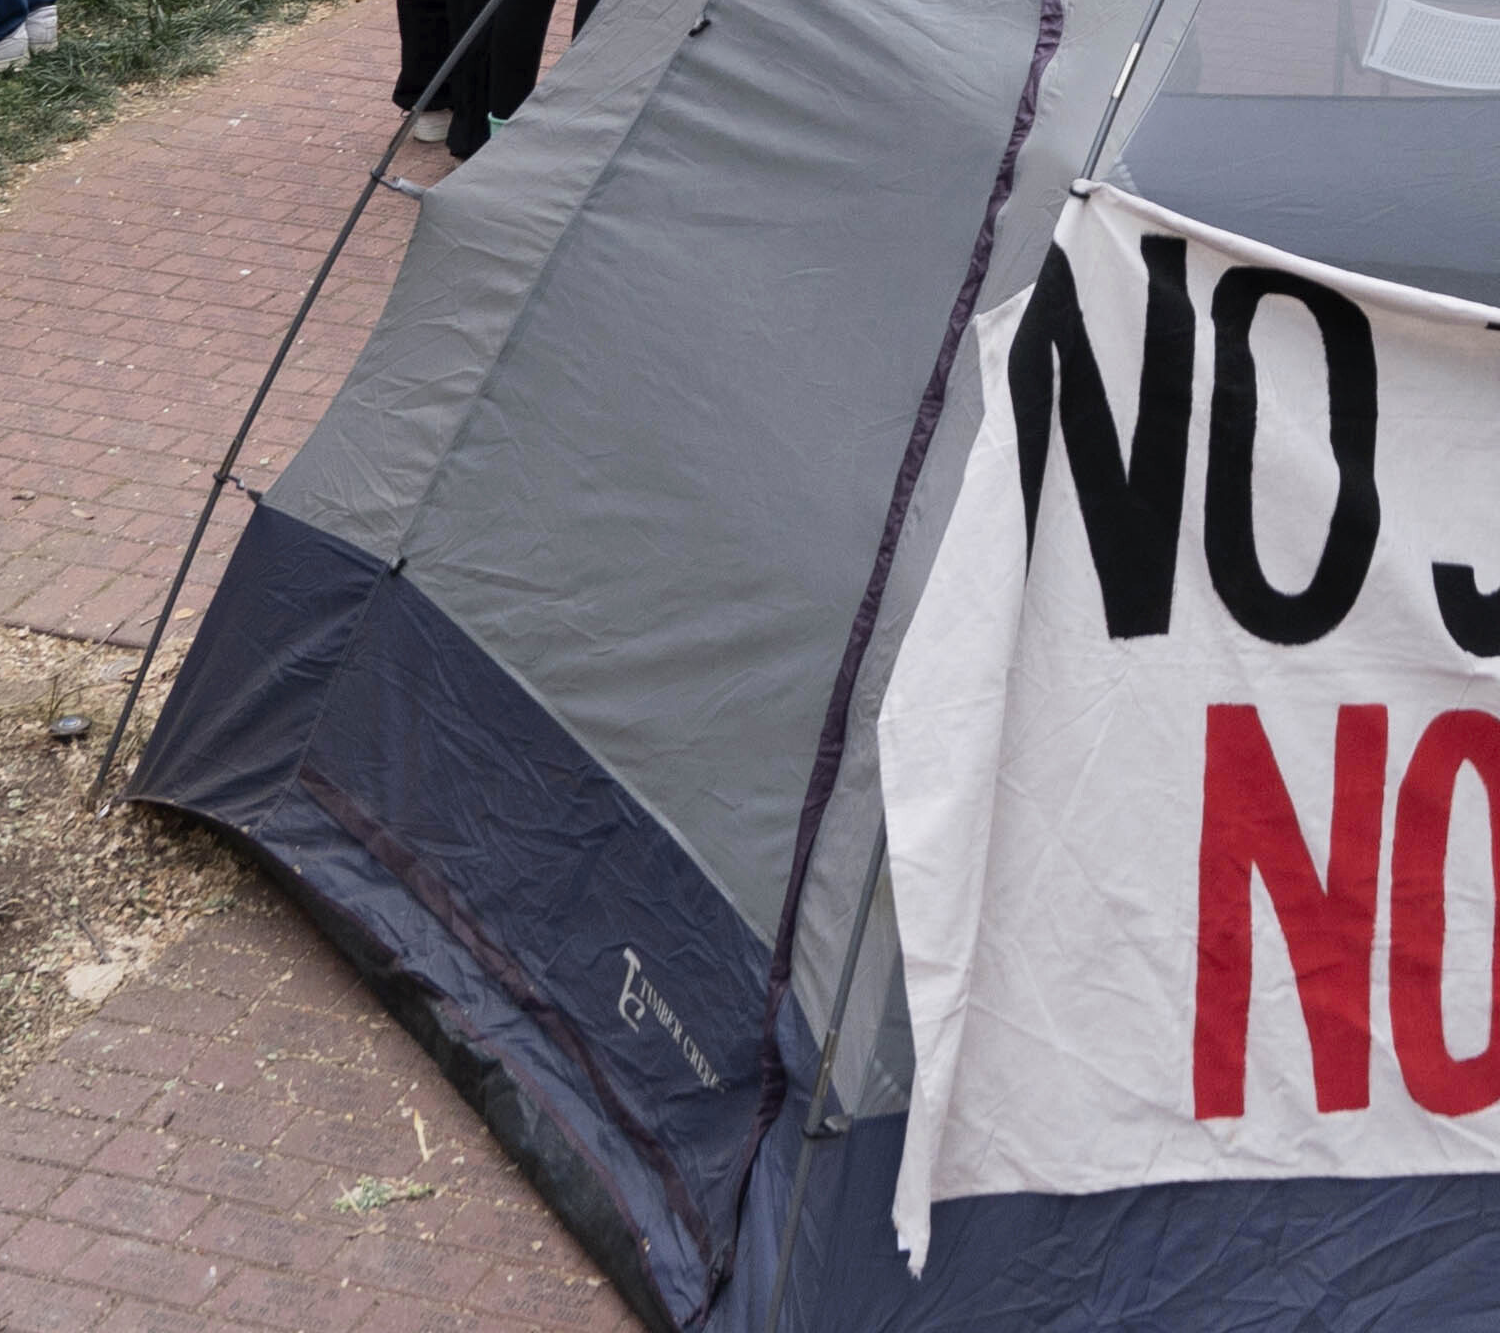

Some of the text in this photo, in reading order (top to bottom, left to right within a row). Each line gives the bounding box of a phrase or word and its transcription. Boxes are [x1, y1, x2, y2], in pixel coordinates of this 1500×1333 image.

[1006, 233, 1383, 645] NO
[641, 975, 721, 1089] TIMBER CREEK
